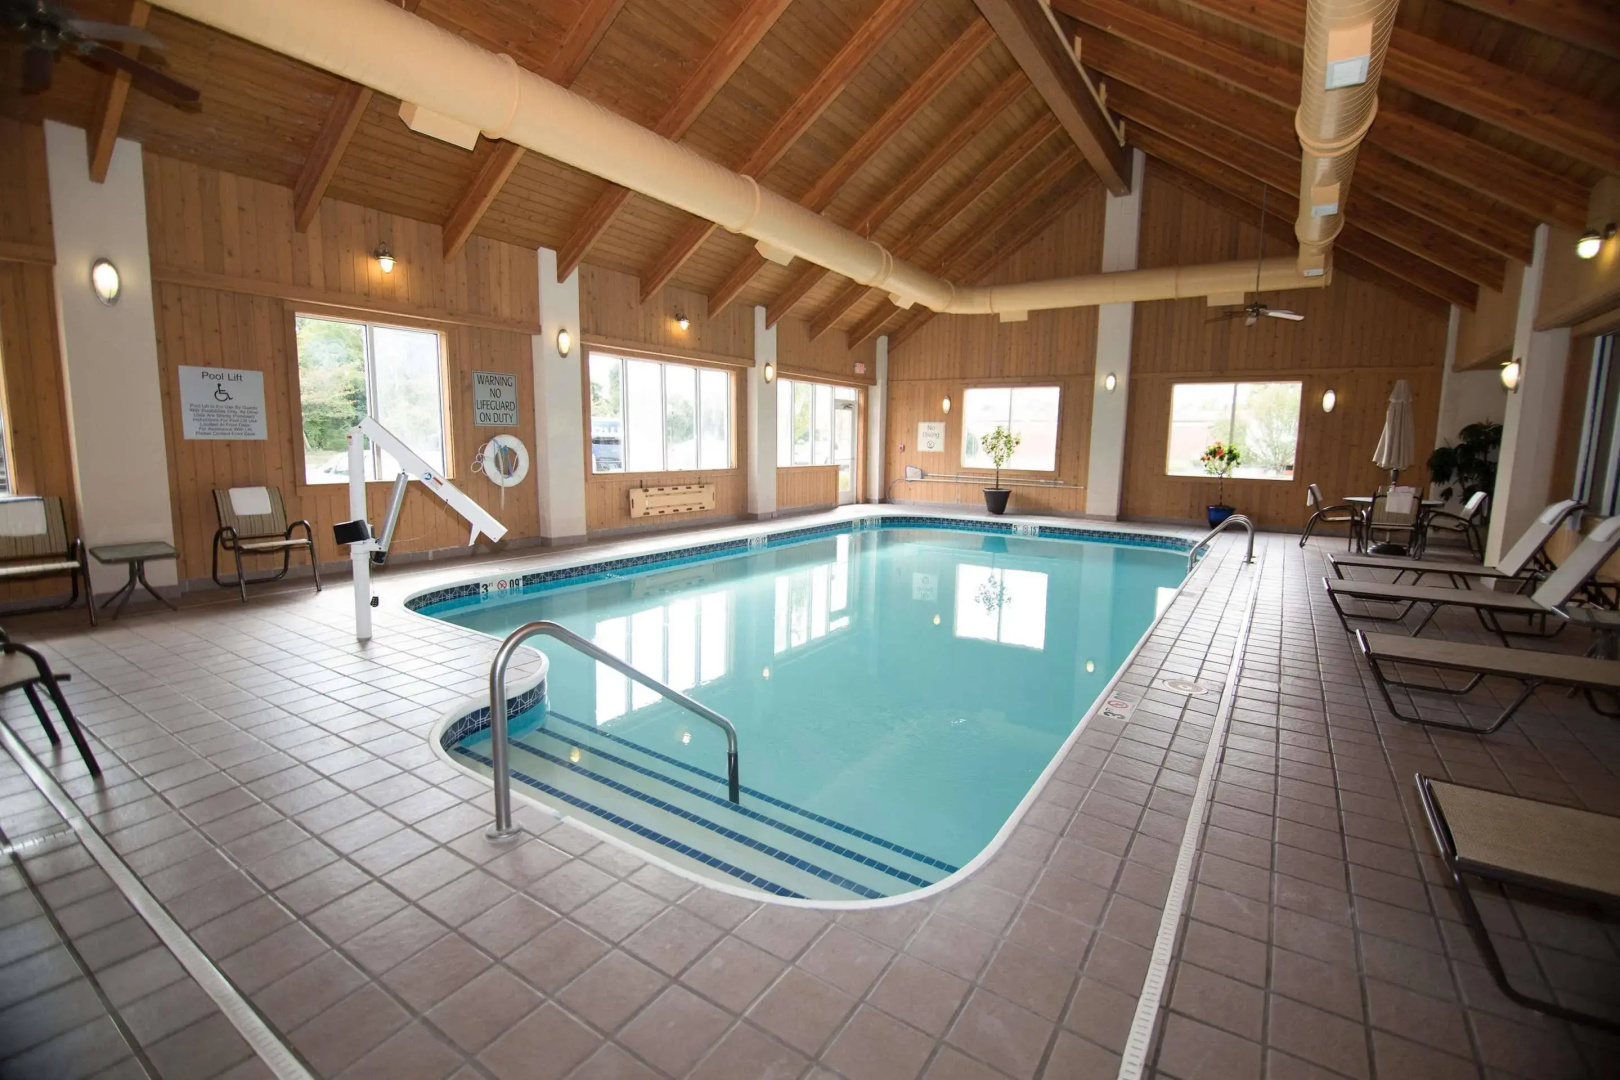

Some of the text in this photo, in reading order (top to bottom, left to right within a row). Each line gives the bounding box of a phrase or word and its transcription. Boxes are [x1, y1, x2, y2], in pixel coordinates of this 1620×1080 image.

[201, 371, 242, 381] Pool Lift
[477, 374, 512, 387] WARNING
[490, 388, 502, 398] NO
[476, 400, 516, 411] LIFEGUARD
[480, 412, 514, 423] ON DUTY
[482, 584, 488, 593] 3
[1103, 711, 1126, 719] 3
